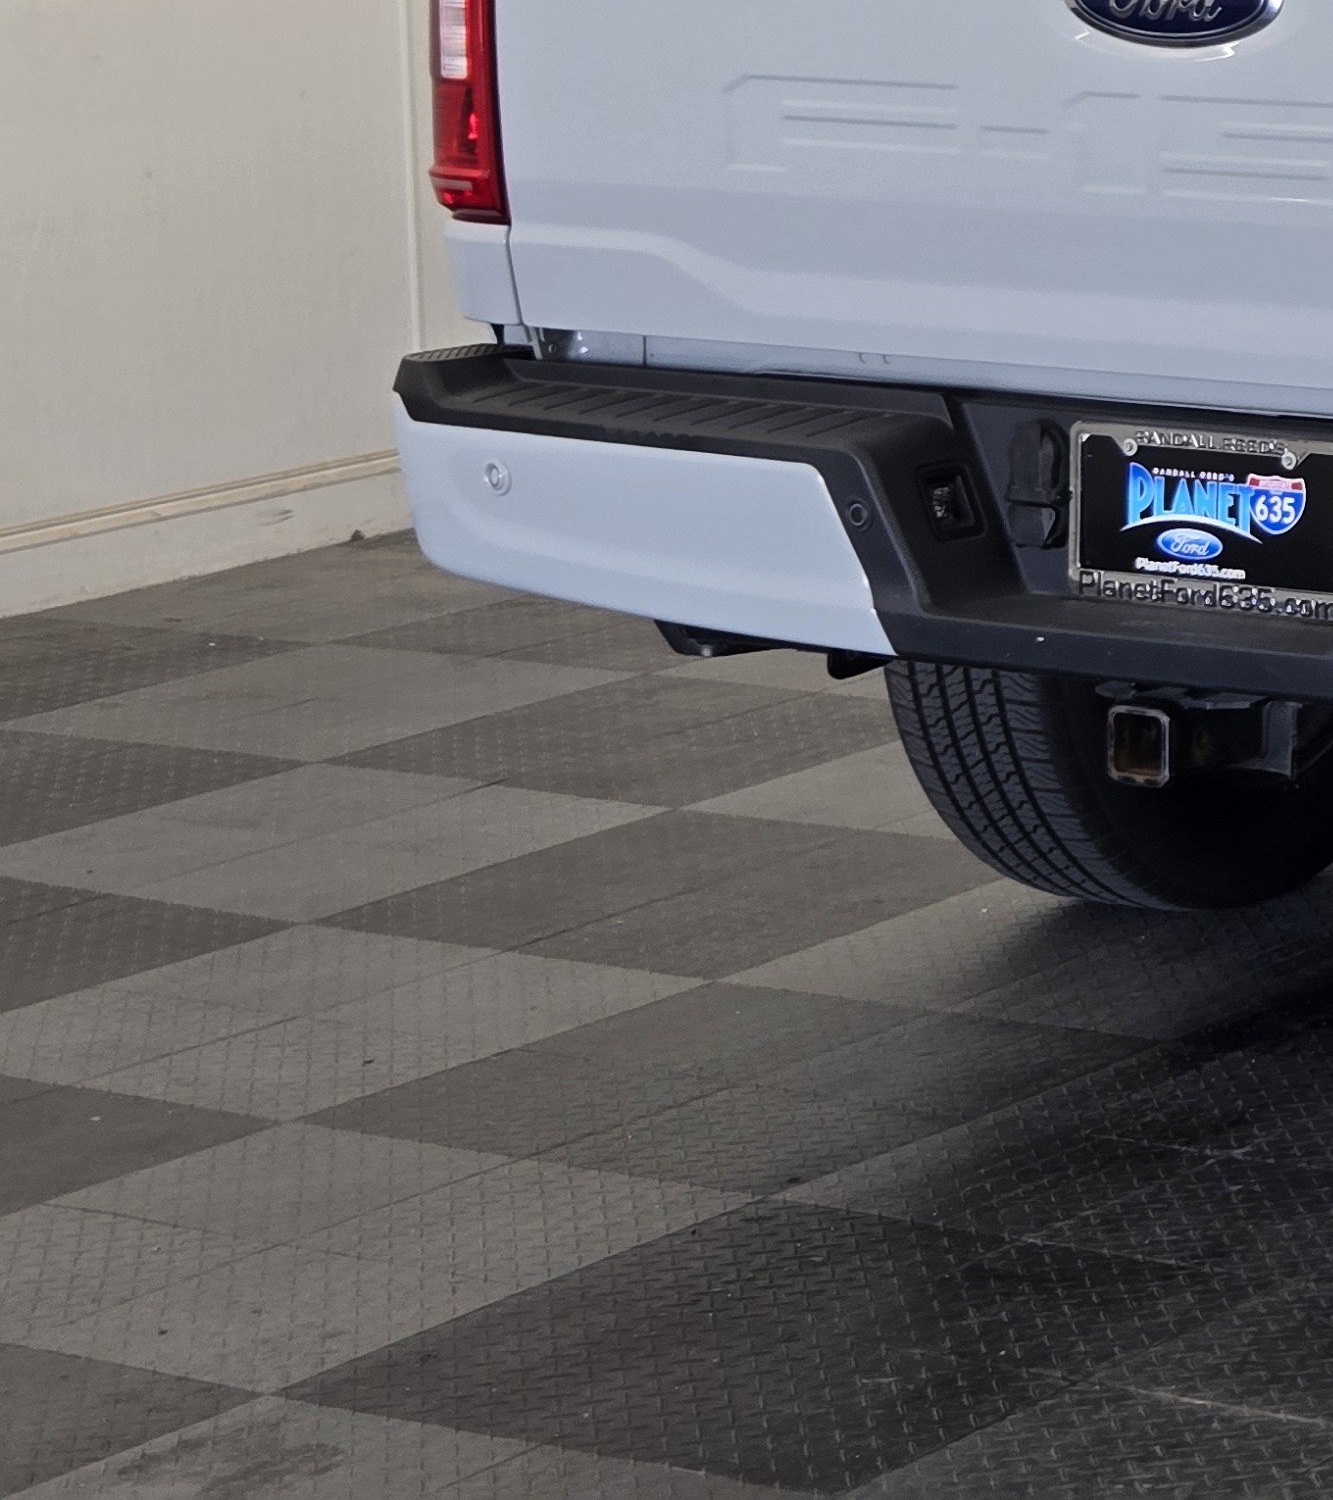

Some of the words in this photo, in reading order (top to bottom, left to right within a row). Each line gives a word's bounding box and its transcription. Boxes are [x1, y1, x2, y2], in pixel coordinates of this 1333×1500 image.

[1137, 430, 1214, 448] RANDALL
[1128, 462, 1255, 534] PLANET
[1254, 494, 1296, 524] 635
[1169, 533, 1211, 556] Ford
